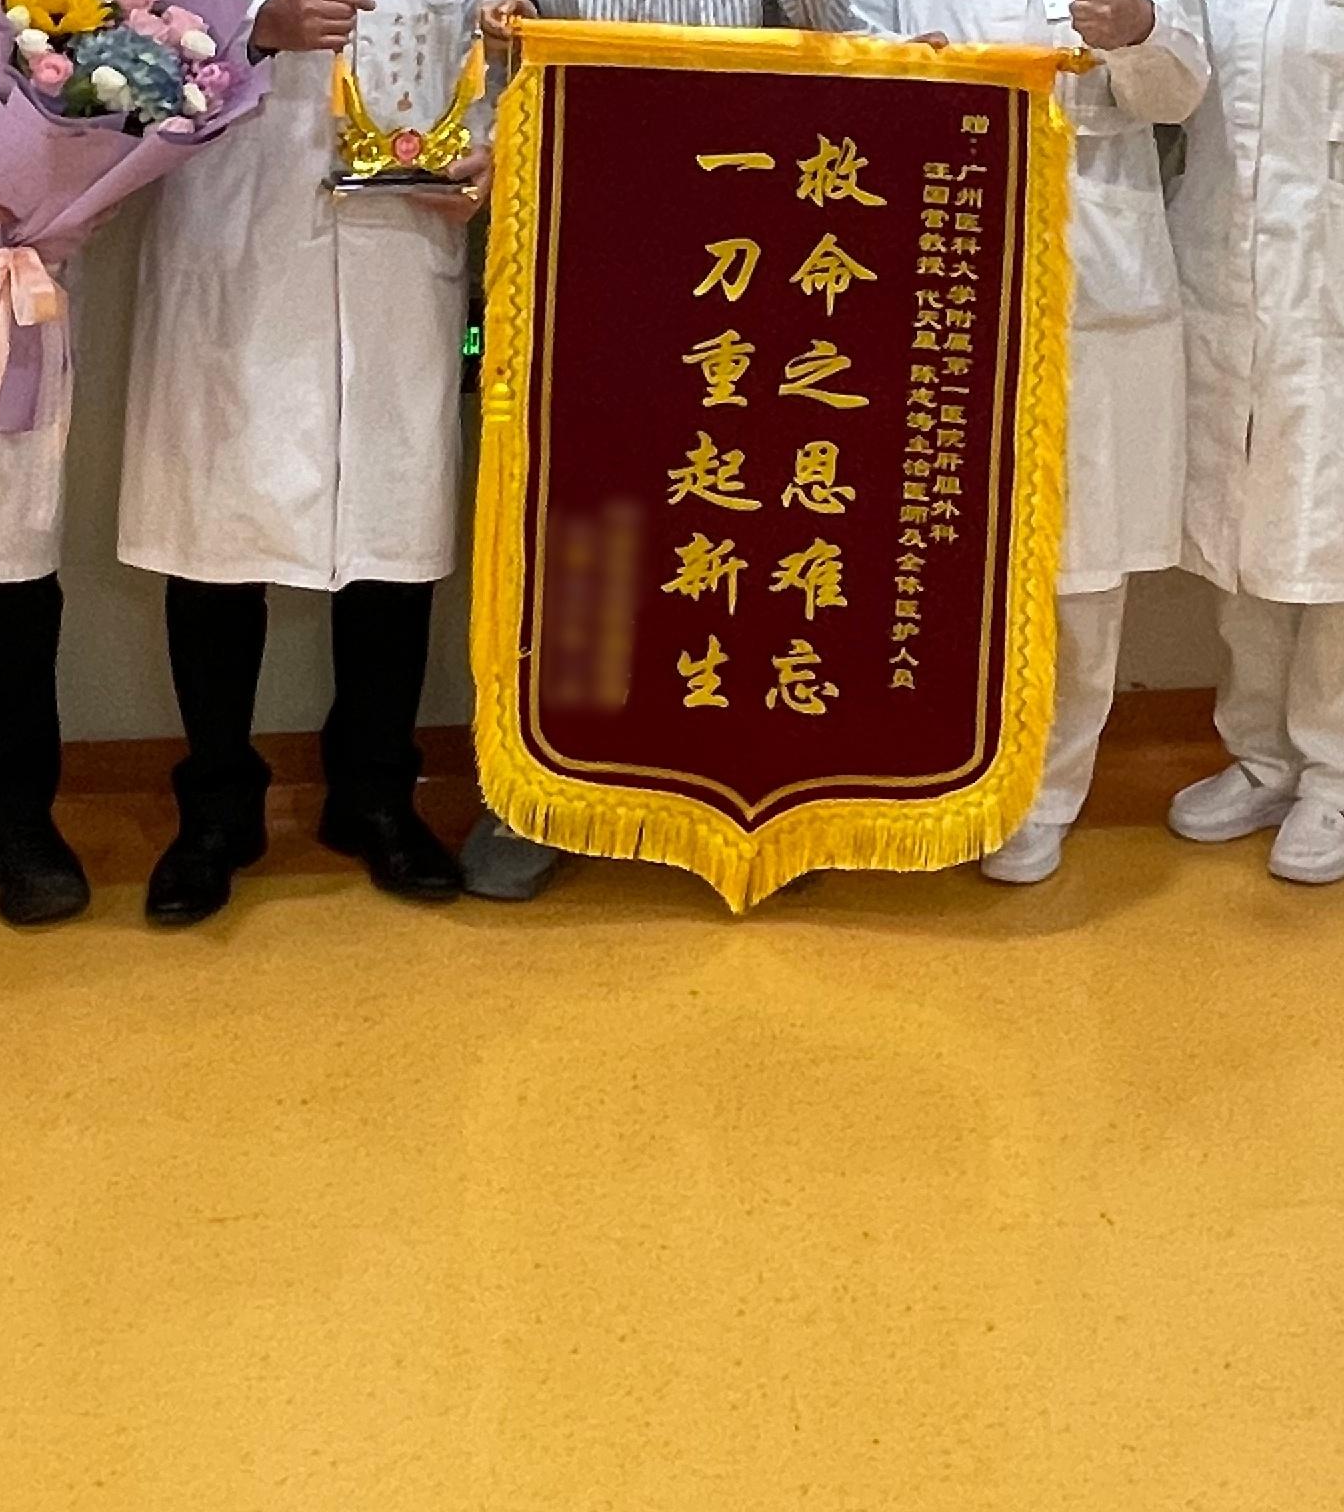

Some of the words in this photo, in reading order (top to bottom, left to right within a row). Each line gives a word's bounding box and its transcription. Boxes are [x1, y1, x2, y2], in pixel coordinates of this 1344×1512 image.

[660, 152, 776, 708] 一刀重起新生
[765, 133, 888, 716] 救命之恩难忘
